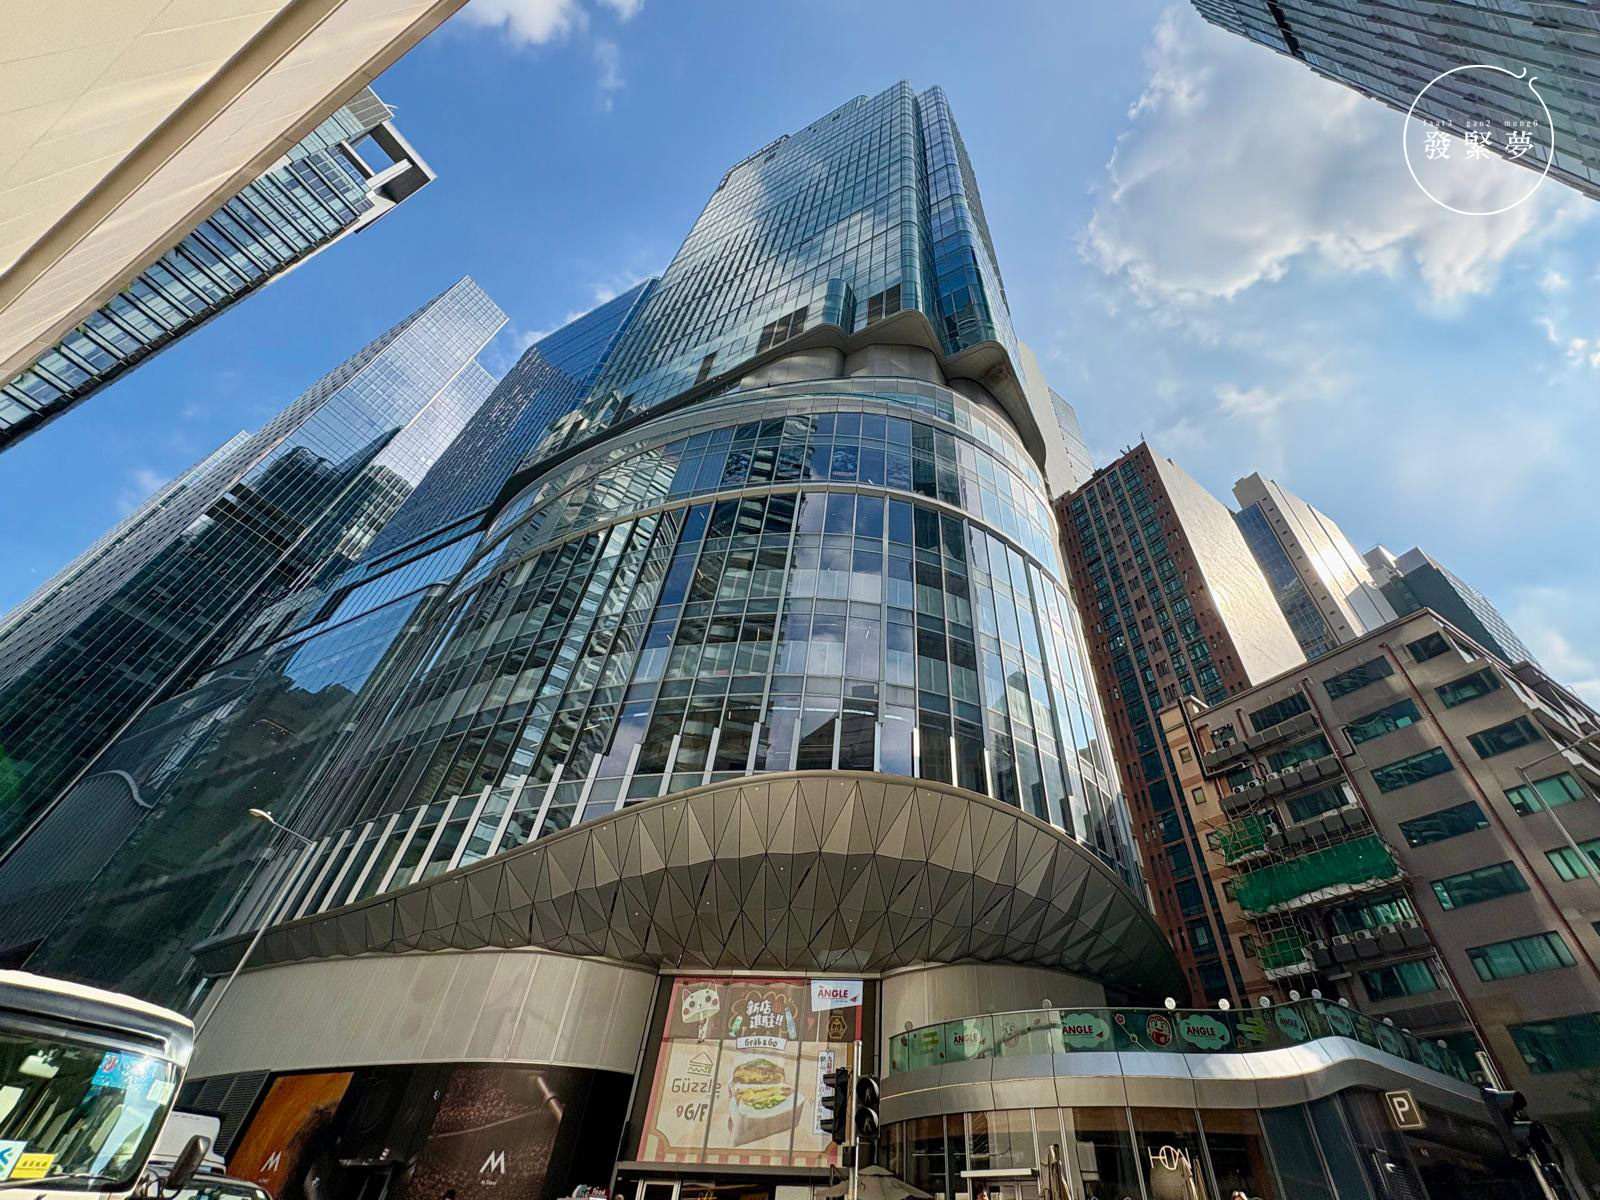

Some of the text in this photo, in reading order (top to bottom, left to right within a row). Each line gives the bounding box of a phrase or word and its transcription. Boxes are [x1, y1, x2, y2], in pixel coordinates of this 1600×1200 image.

[817, 989, 849, 998] ANGLE
[746, 1000, 771, 1015] 新店
[1062, 1025, 1094, 1035] ANGLE
[1186, 1026, 1217, 1037] ANGLE
[745, 1038, 761, 1047] Grab
[768, 1039, 778, 1047] Go
[684, 1103, 709, 1122] G/F
[1393, 1096, 1410, 1123] P
[479, 1150, 505, 1174] M
